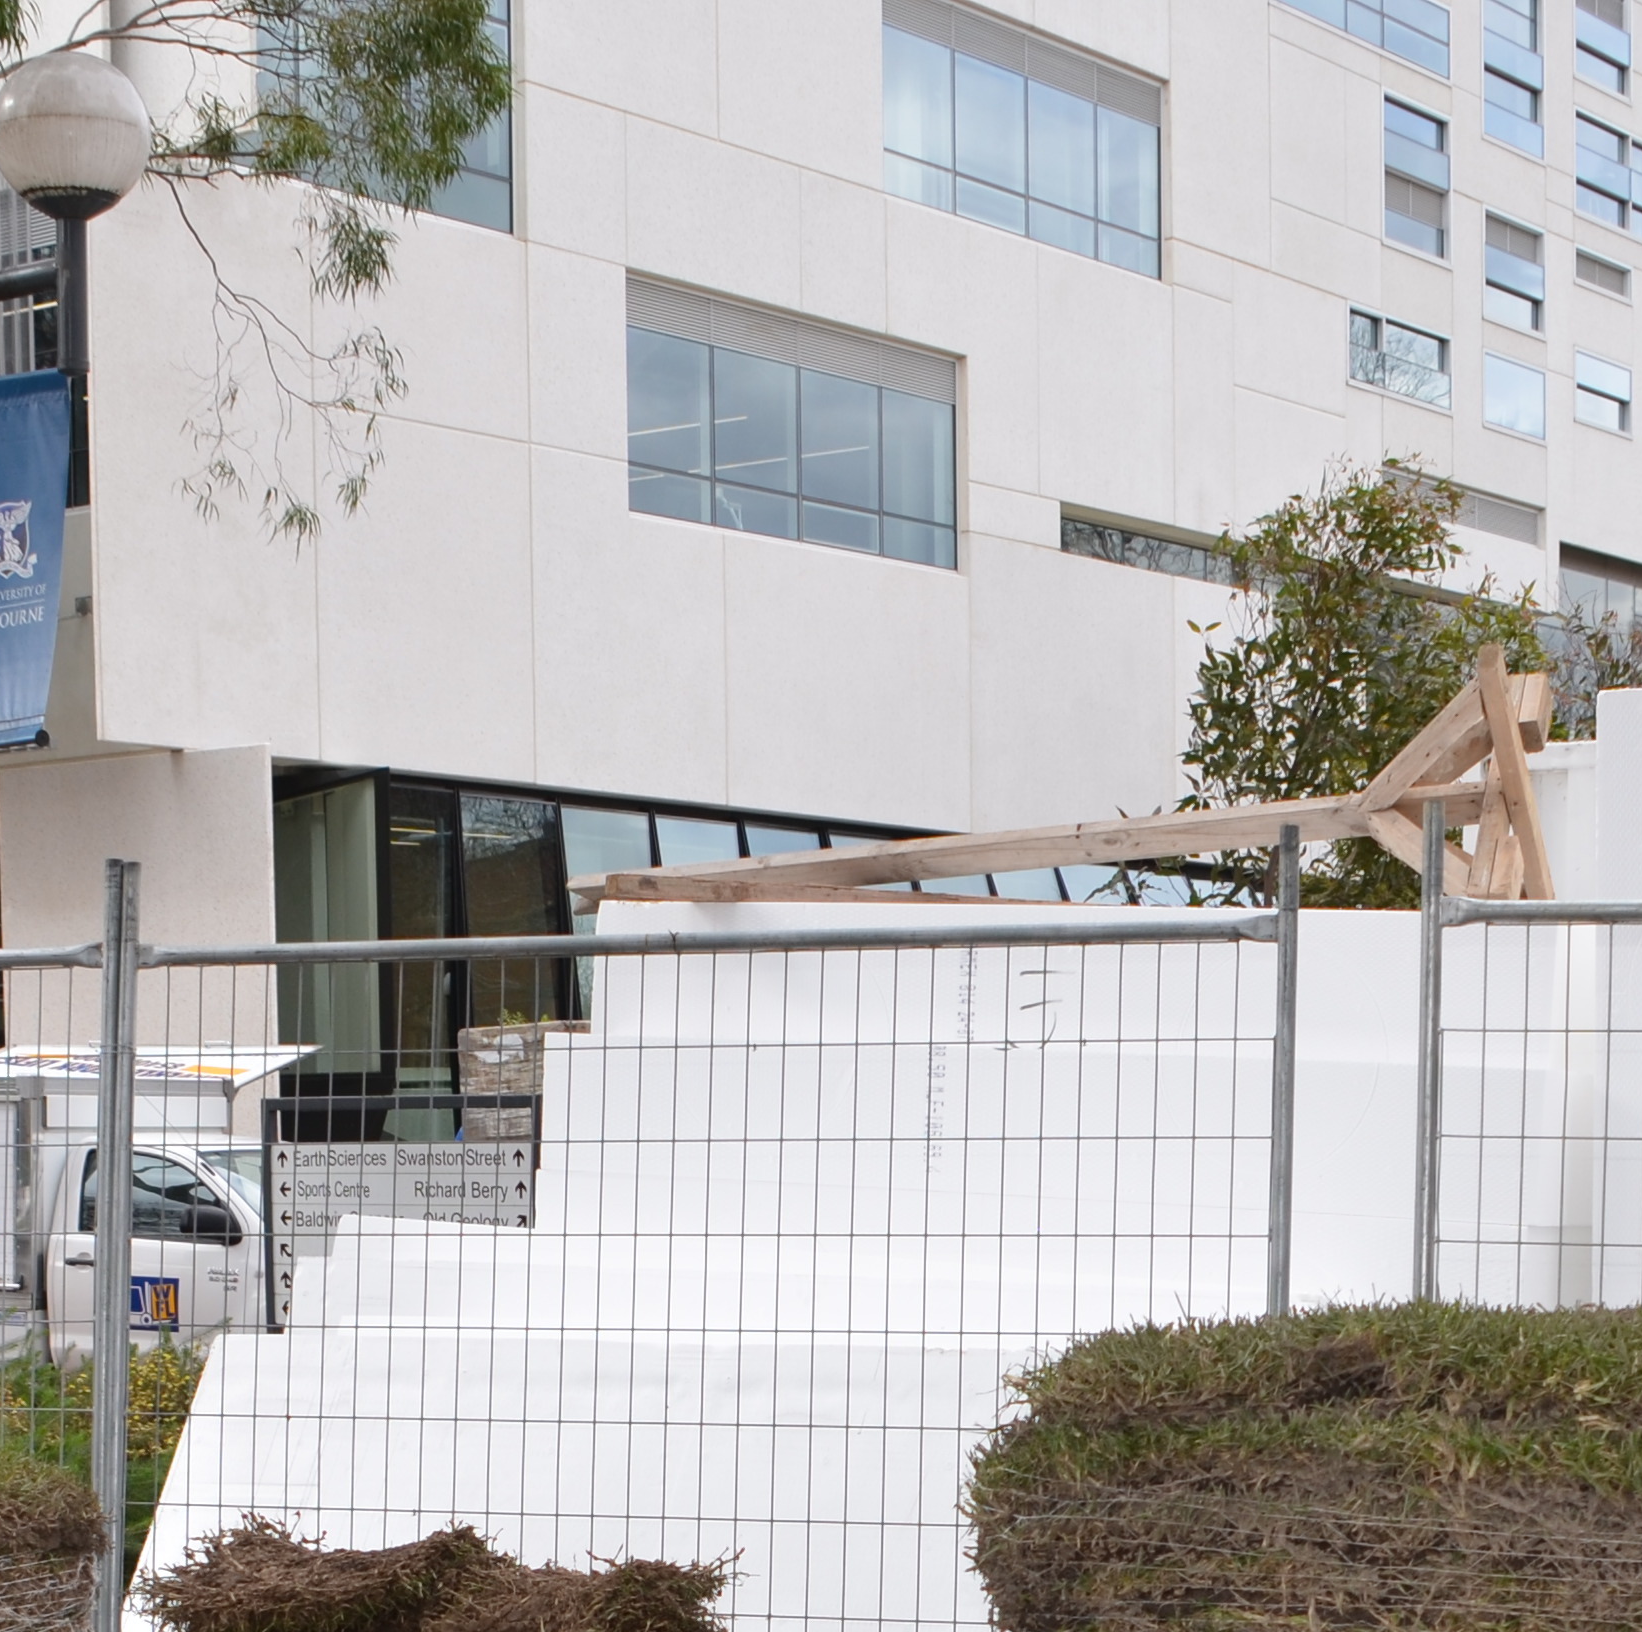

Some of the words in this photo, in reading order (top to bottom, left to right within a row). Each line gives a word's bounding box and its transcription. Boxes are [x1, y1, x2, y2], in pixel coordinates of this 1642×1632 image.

[35, 583, 47, 595] OF
[293, 1150, 326, 1167] Earth
[327, 1149, 387, 1167] Sciences
[397, 1148, 463, 1167] Swanston
[465, 1148, 507, 1166] Street
[297, 1181, 331, 1201] Sports
[334, 1181, 370, 1198] Centre
[414, 1181, 465, 1199] Richard
[470, 1181, 509, 1203] Berry
